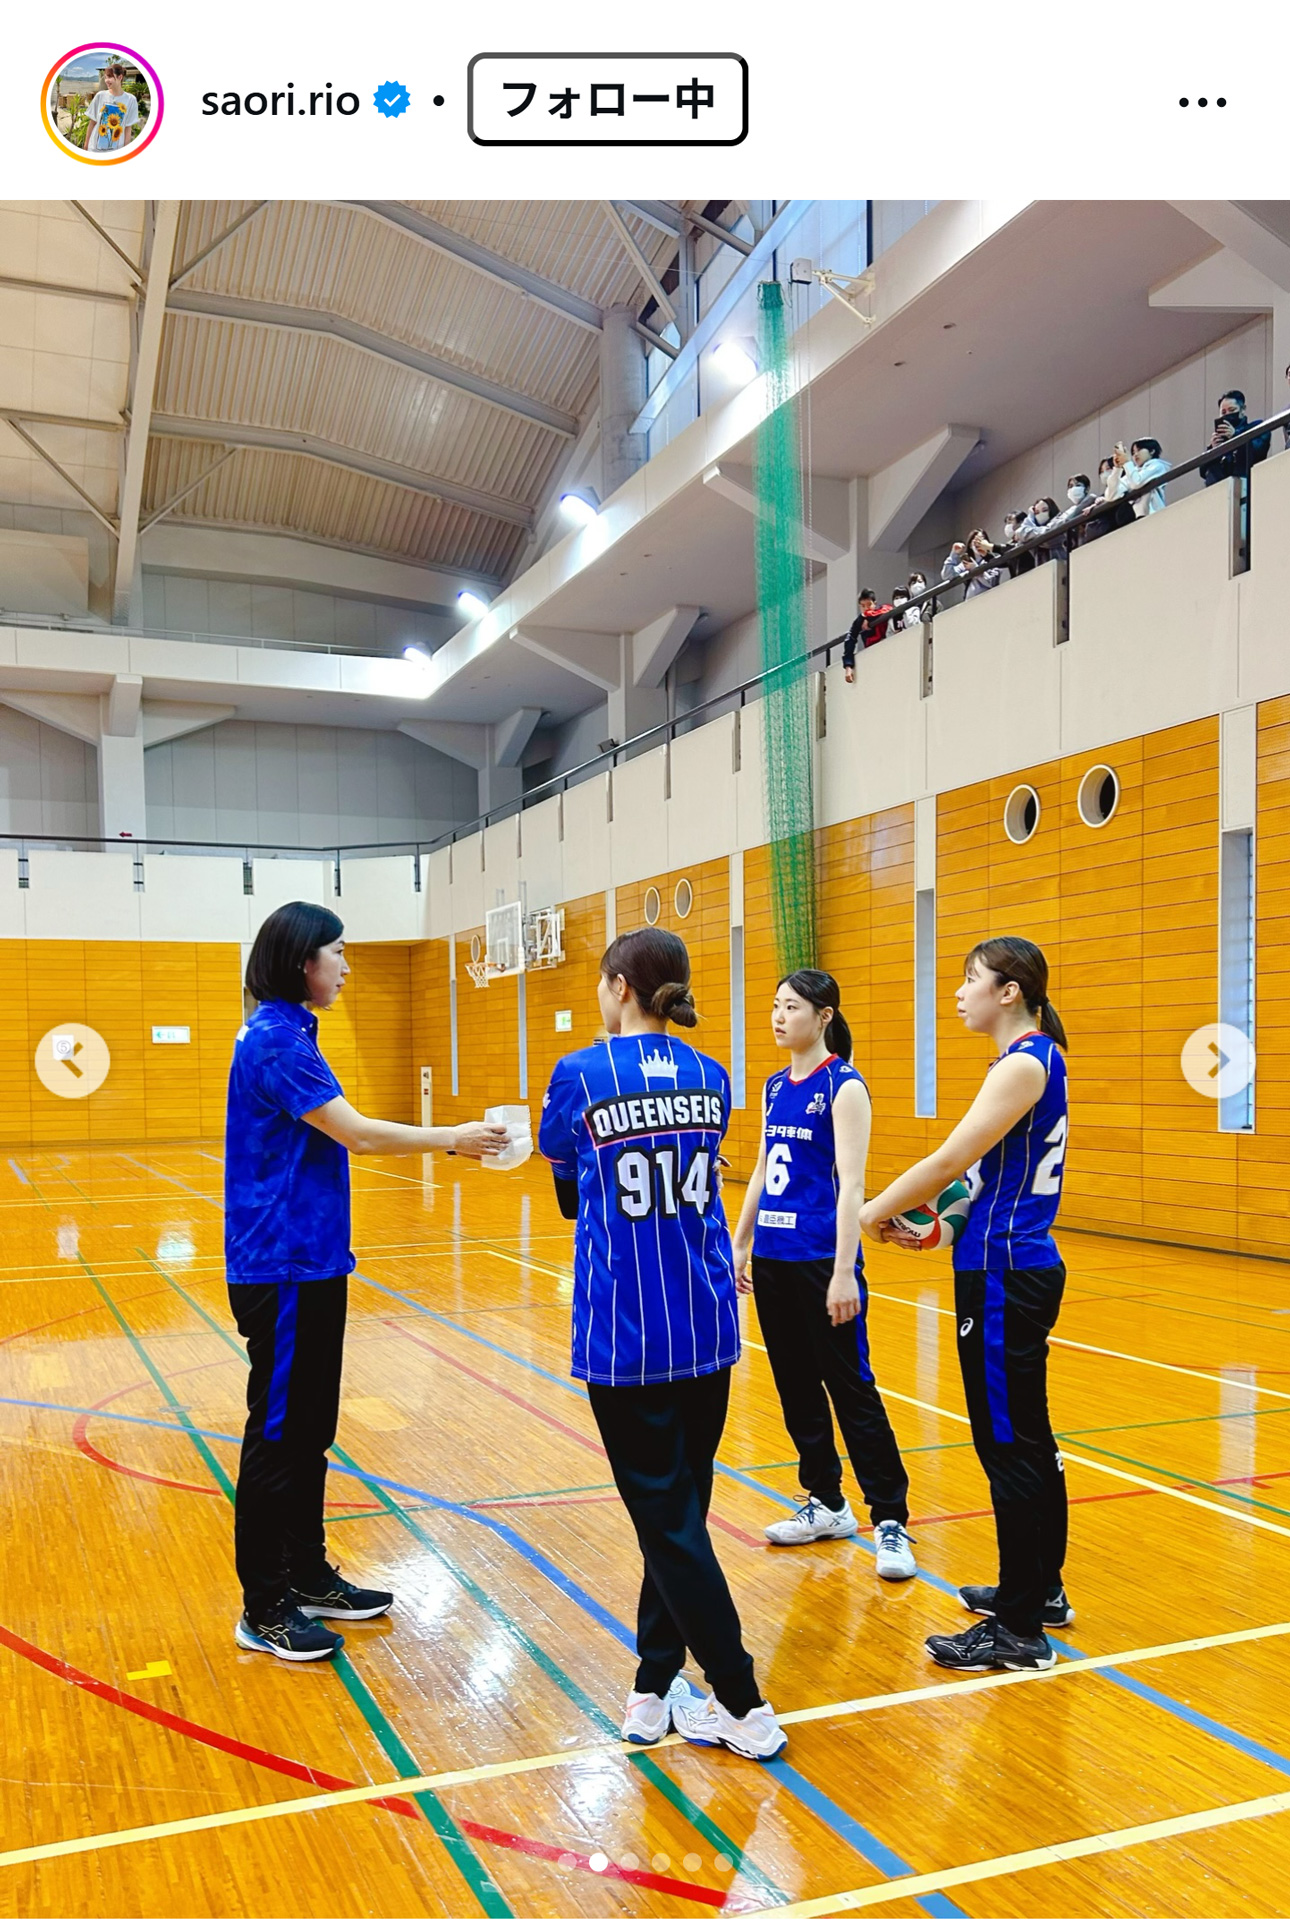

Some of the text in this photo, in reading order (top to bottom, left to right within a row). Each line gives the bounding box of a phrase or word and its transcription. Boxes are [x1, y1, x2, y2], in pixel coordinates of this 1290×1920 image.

[592, 1095, 722, 1138] QUEENSEIS
[765, 1125, 813, 1141] ヨタ車体
[616, 1150, 711, 1217] 914
[765, 1143, 793, 1196] 6
